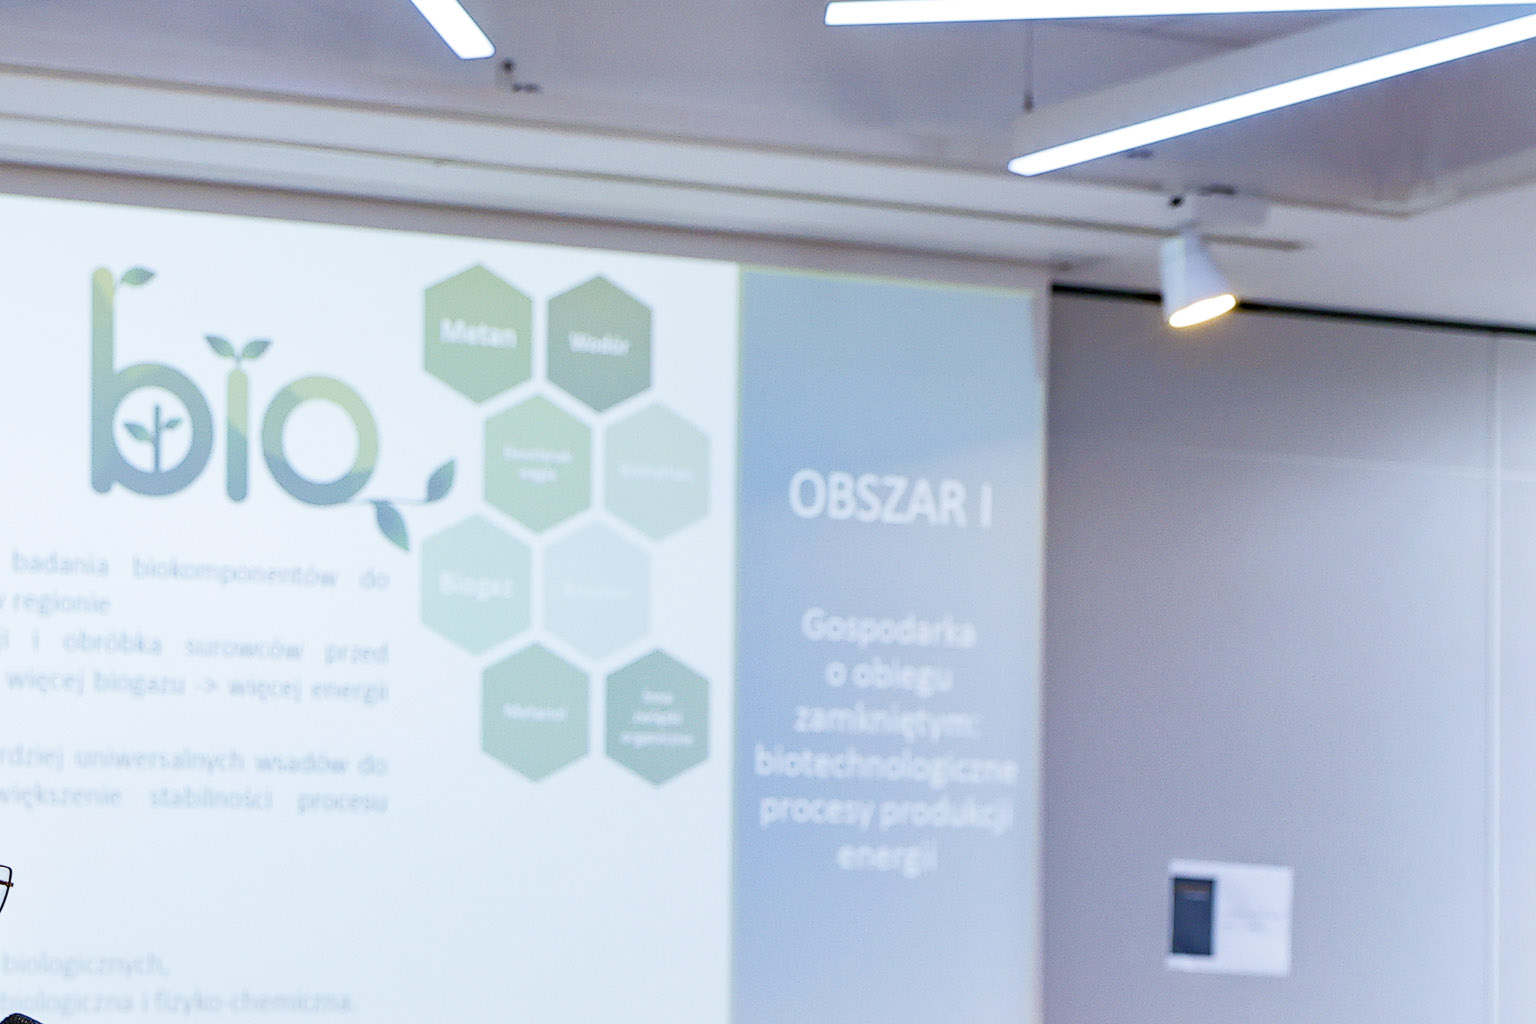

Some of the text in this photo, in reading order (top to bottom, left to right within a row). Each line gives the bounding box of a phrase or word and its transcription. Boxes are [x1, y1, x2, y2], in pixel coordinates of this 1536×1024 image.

[789, 468, 968, 527] OBSZAR
[12, 550, 109, 577] badania
[360, 568, 390, 591] do
[13, 590, 112, 618] regionie
[62, 629, 162, 656] obróbka
[801, 606, 977, 650] Gospodarka
[825, 656, 953, 699] o obiegu
[755, 743, 1020, 790] biotechnologiczne
[760, 796, 1014, 836] procesy produkcji
[836, 840, 938, 879] energii
